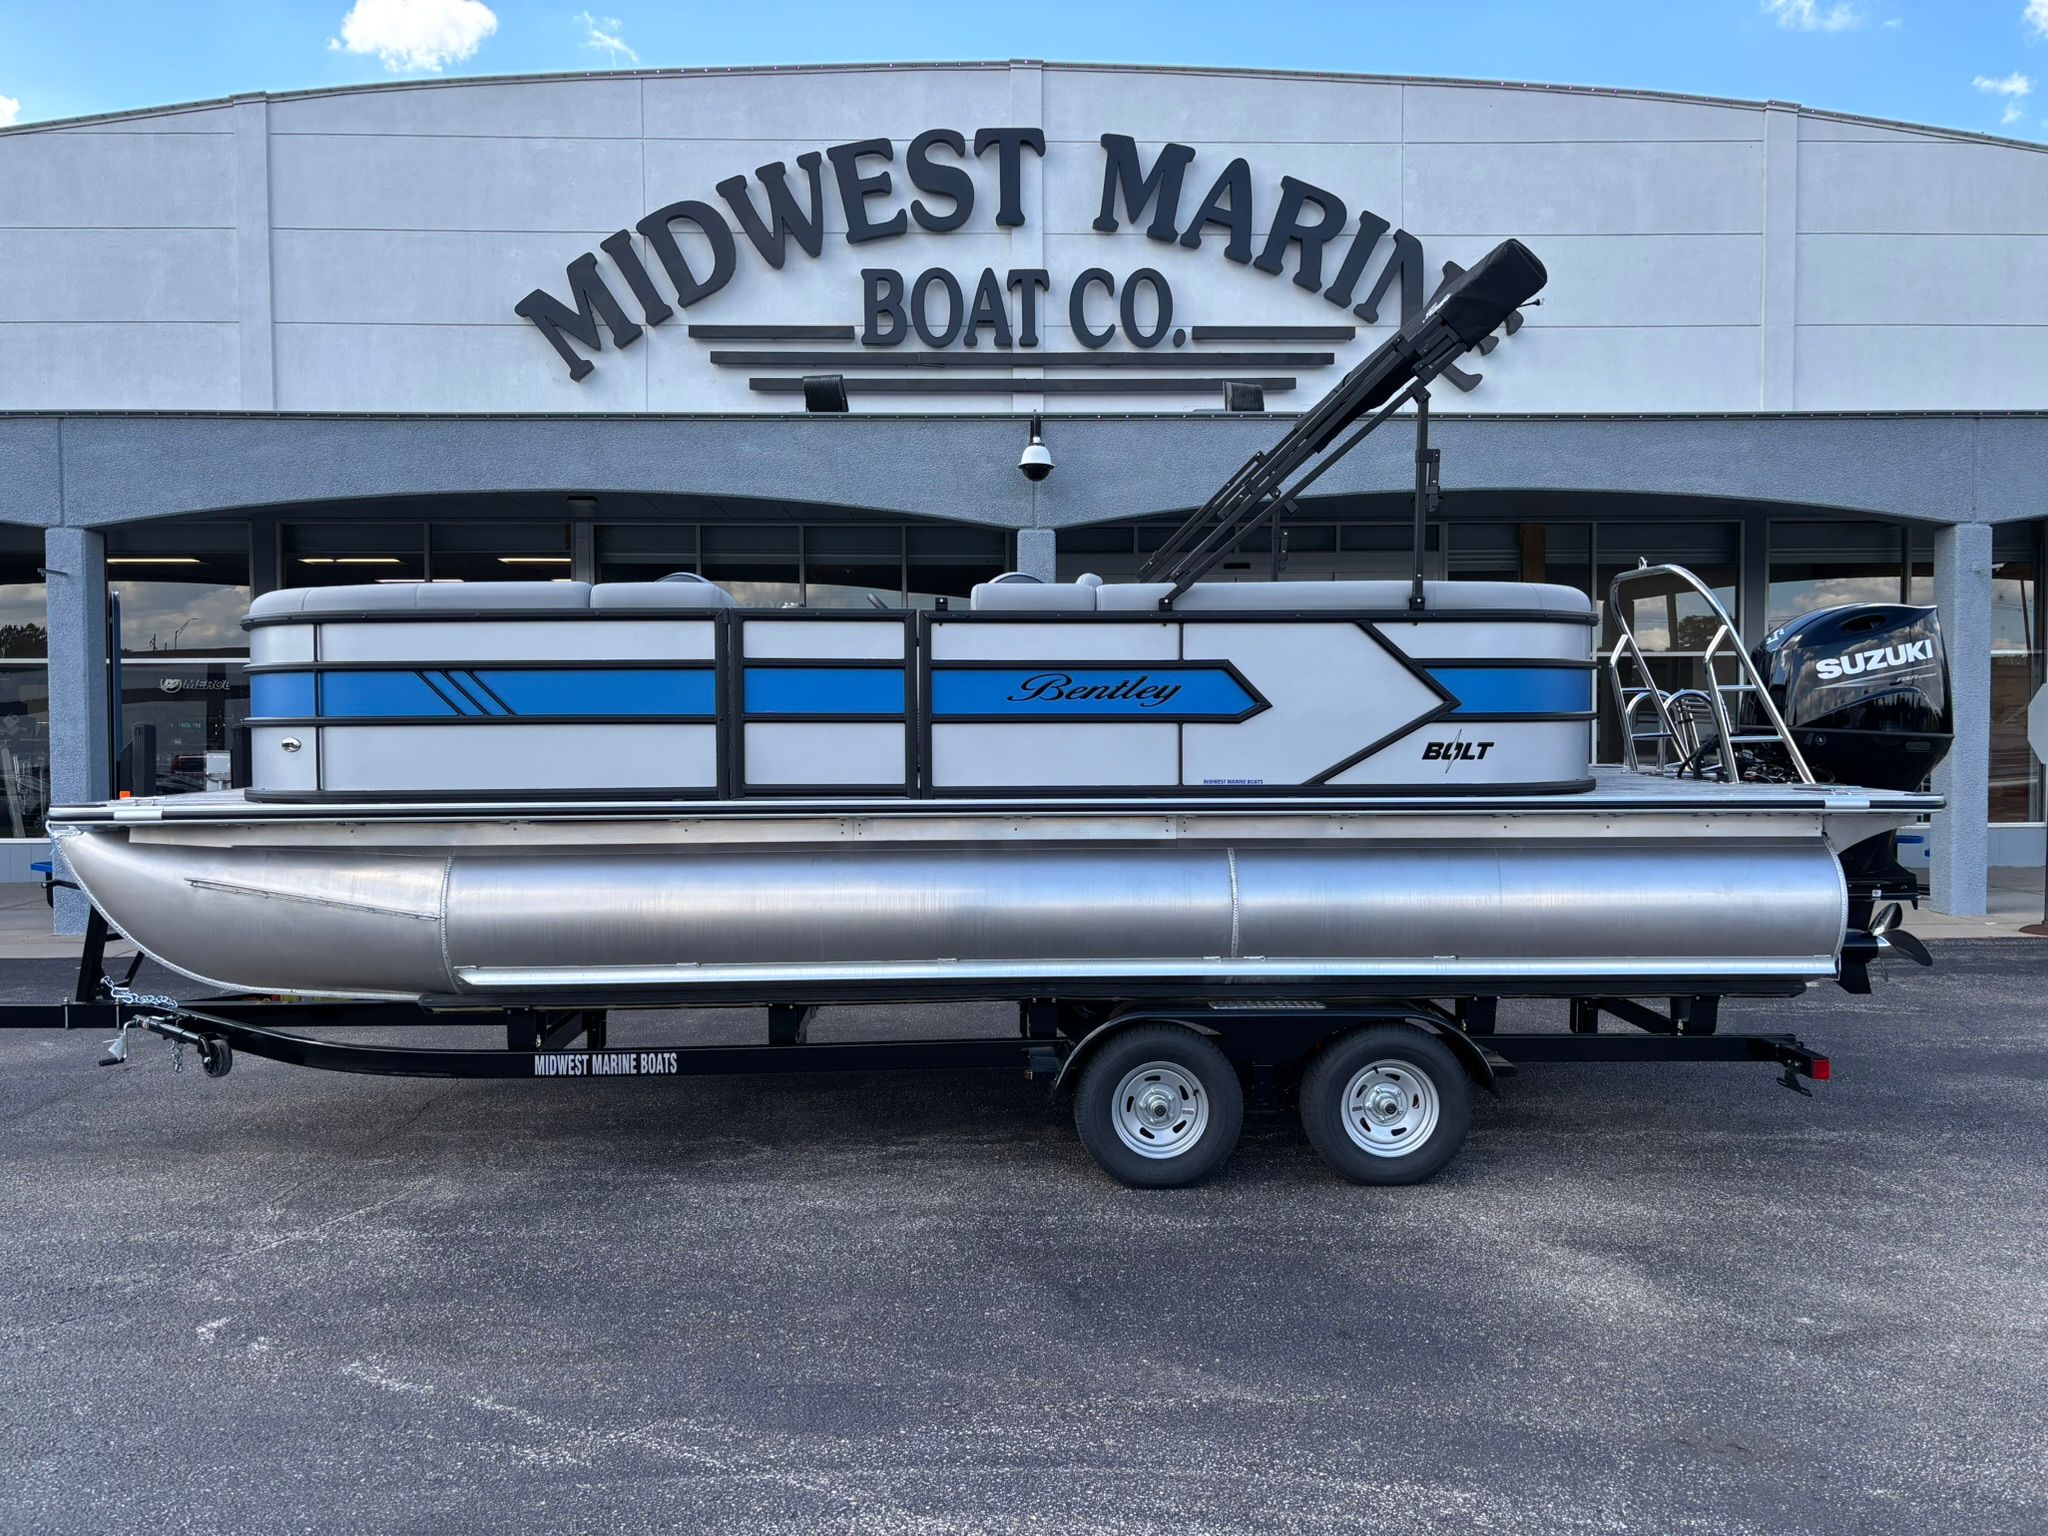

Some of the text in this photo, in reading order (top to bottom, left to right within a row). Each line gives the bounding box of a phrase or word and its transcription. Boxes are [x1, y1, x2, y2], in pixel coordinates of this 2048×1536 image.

[514, 127, 1047, 382] MIDWEST
[861, 267, 1187, 348] BOAT CO.
[1815, 639, 1934, 680] SUZUKI
[1006, 673, 1183, 708] Bentley
[534, 1052, 678, 1076] MIDWEST MARINE BOATS
